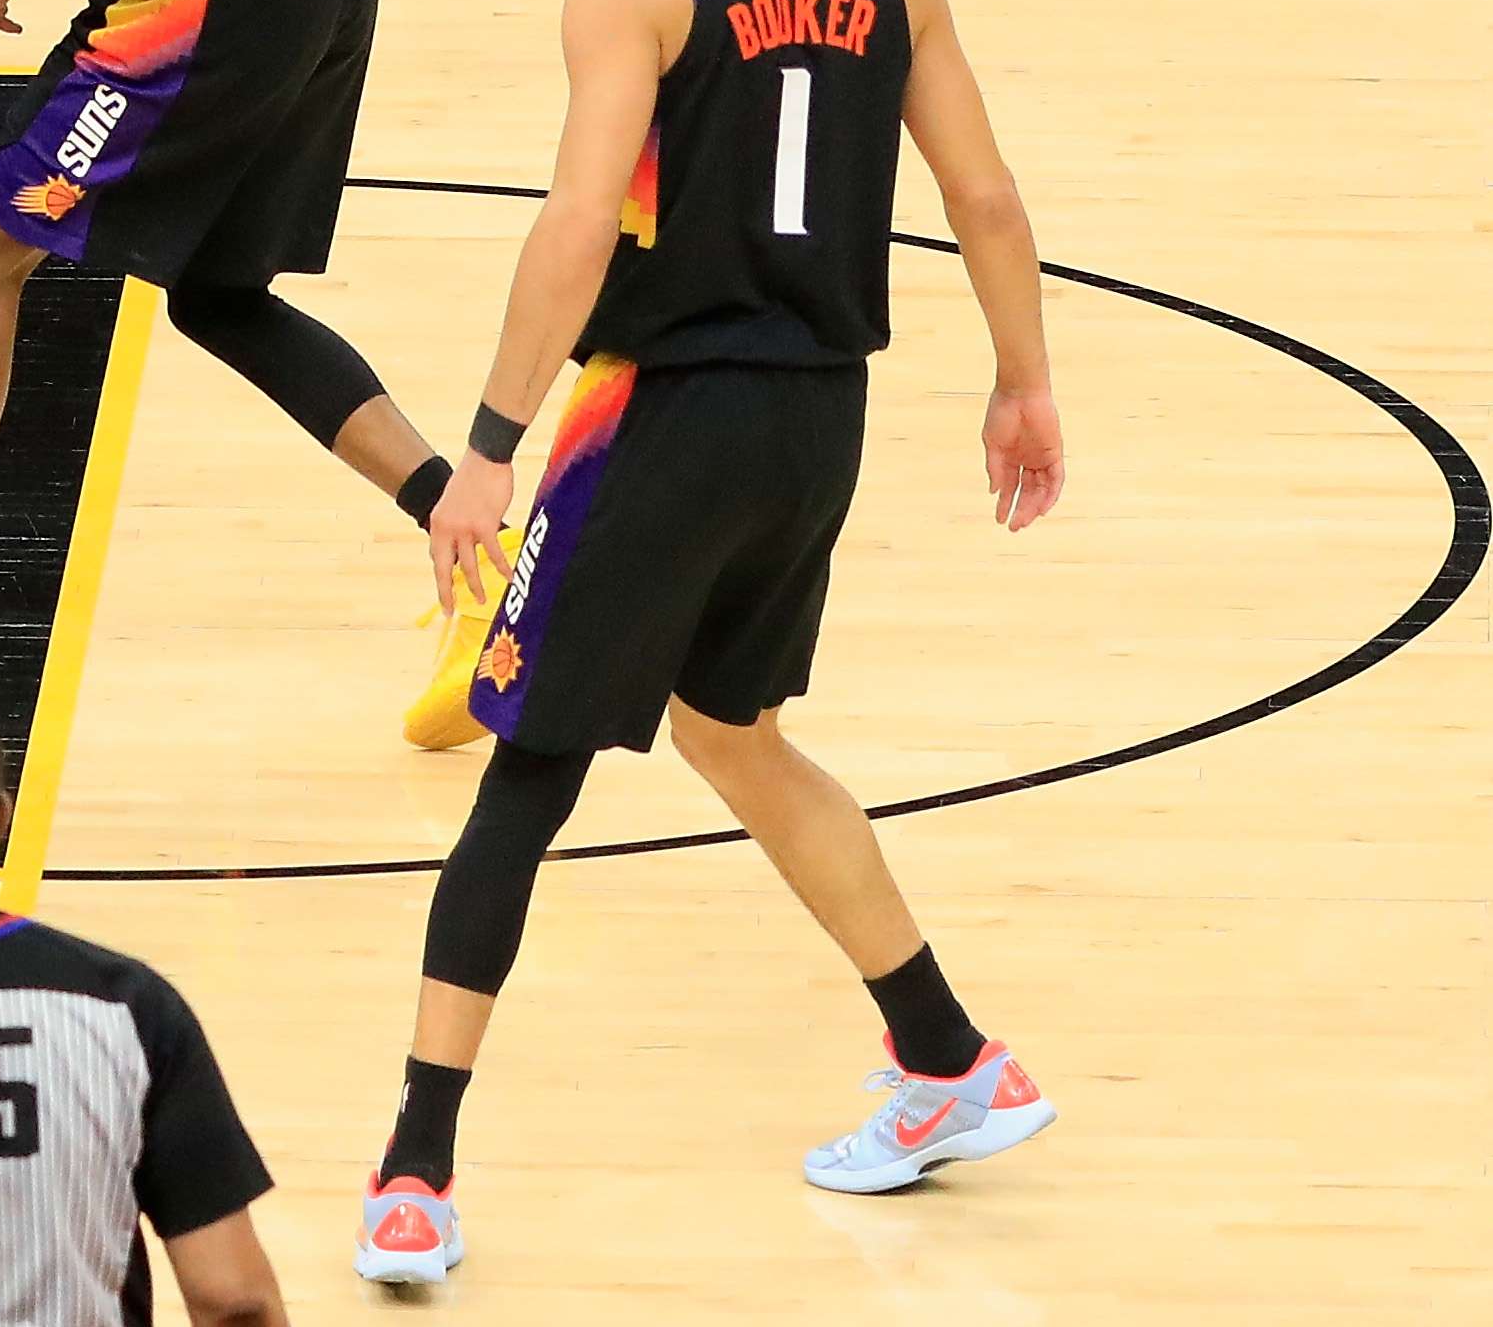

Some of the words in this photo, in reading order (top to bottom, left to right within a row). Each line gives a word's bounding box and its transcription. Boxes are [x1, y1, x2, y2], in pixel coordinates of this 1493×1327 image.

[55, 83, 130, 179] SUNS
[773, 68, 813, 238] 1
[504, 507, 550, 627] SUNS
